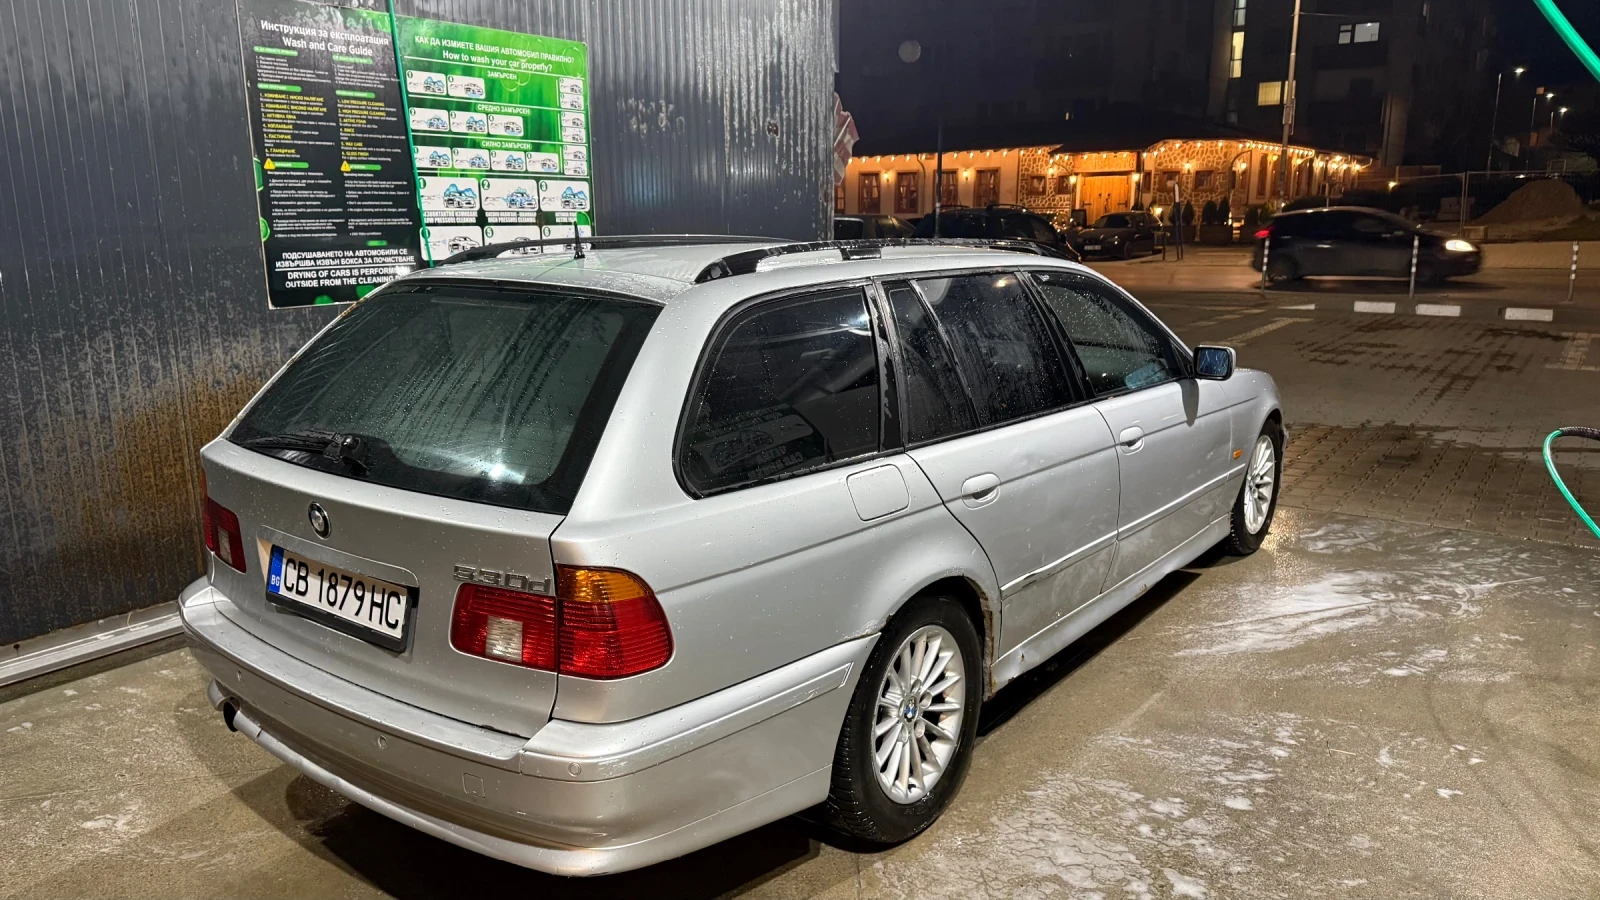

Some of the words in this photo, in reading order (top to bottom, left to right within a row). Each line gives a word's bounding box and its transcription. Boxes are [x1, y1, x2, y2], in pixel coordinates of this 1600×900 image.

[260, 20, 316, 36] Инструкция
[318, 30, 328, 38] за
[330, 30, 389, 46] експлоатация
[282, 36, 306, 49] Wash
[309, 40, 326, 51] and
[328, 43, 346, 54] Care
[349, 45, 373, 56] Guide
[414, 35, 430, 44] КАК
[430, 38, 440, 46] ДА
[442, 40, 474, 50] ИЗМИЕТЕ
[476, 44, 500, 54] ВАШИЯ
[500, 47, 540, 58] АВТОМОБИЛ
[540, 52, 574, 64] ПРАВИЛНО?
[442, 50, 460, 59] How
[470, 54, 490, 64] wash
[491, 58, 507, 67] your
[508, 60, 520, 68] car
[487, 71, 517, 80] ЗАМЪРСЕН
[477, 104, 500, 113] СРЕДНО
[501, 106, 530, 115] ЗАМЪРСЕН
[502, 142, 531, 150] ЗАМЪРСЕН
[282, 251, 343, 260] ПОДСУШАВАНЕТО
[287, 271, 317, 280] DRYING
[286, 280, 319, 288] OUTSIDE
[358, 276, 394, 284] CLEANING
[271, 575, 280, 586] BG
[284, 558, 309, 596] CB
[318, 568, 366, 616] 1879
[369, 585, 401, 629] HC
